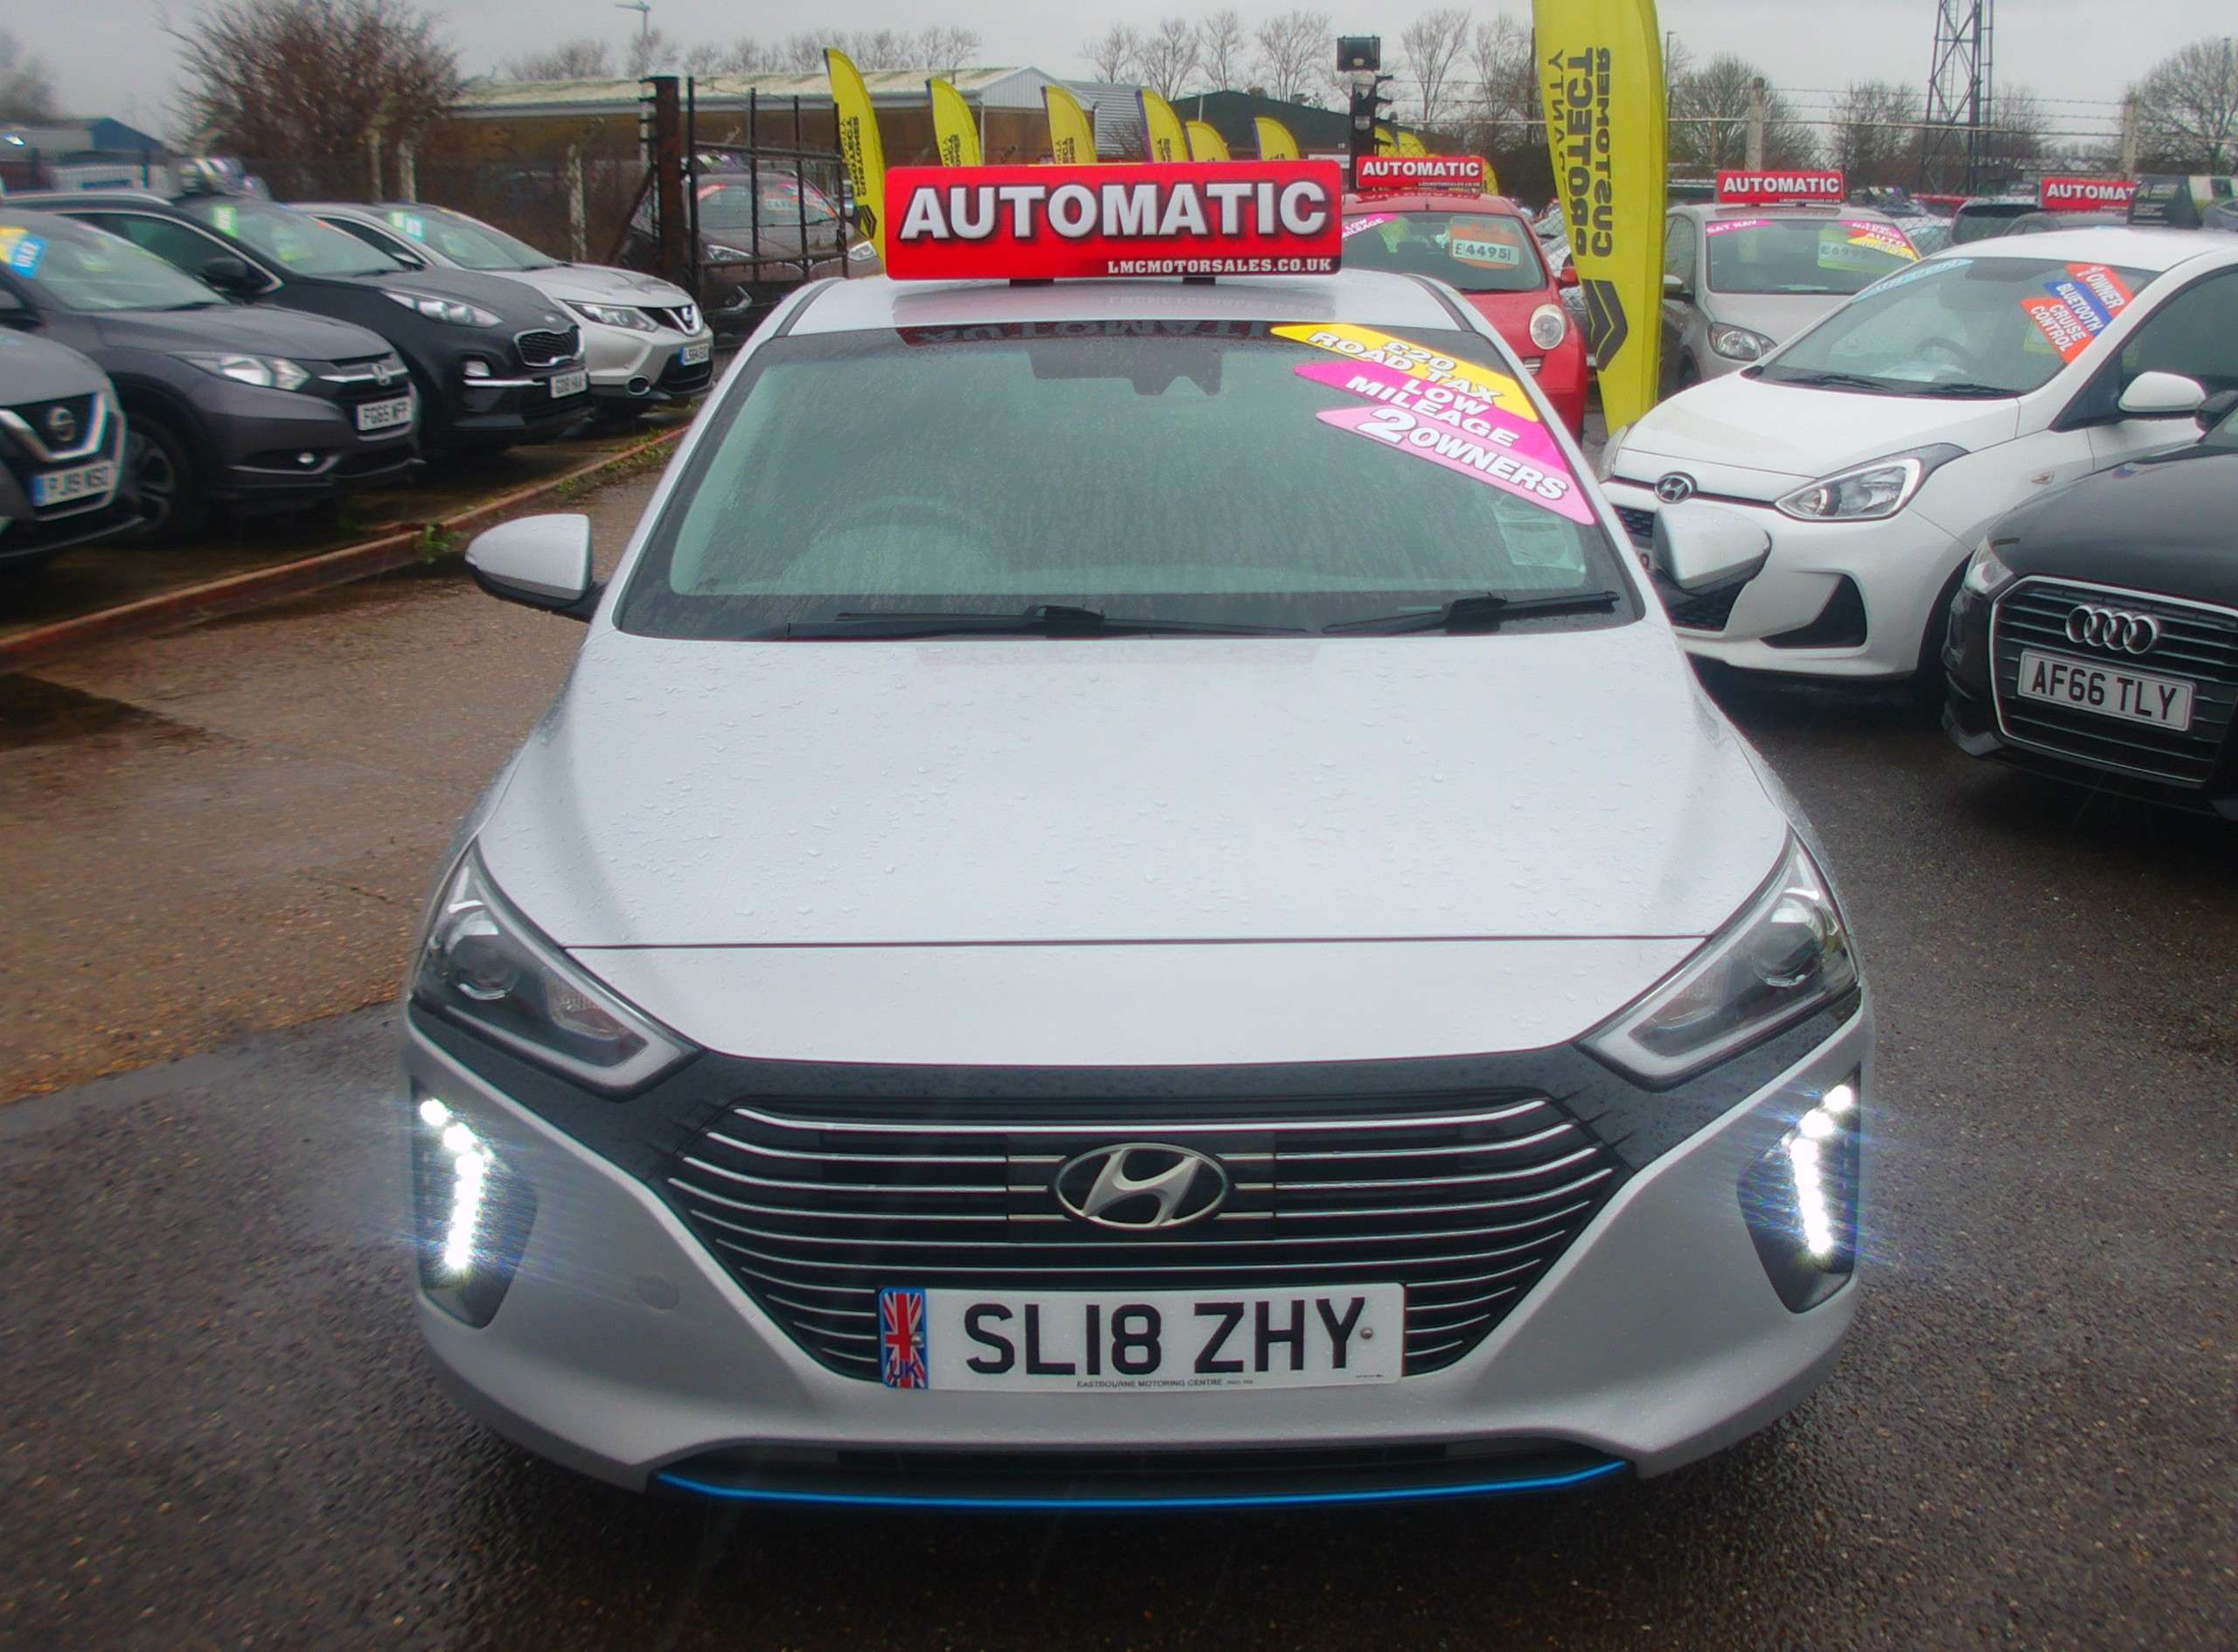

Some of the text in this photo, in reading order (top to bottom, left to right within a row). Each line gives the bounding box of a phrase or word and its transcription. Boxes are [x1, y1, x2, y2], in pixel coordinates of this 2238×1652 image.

[1362, 162, 1479, 177] AUTOMATIC
[1723, 177, 1839, 193] AUTOMATIC
[900, 180, 1326, 240] AUTOMATIC
[1108, 258, 1331, 274] LMCMOTORSALES.CO.UK
[2055, 282, 2104, 331] BLUETOOTH
[2085, 273, 2125, 309] OWNER
[2030, 305, 2074, 351] CONTROL
[2049, 304, 2087, 342] CRUISE
[1308, 331, 1505, 405] ROAD TAX
[1381, 341, 1456, 371] £20
[1345, 376, 1520, 448] MILEAGE
[1401, 378, 1490, 416] LOW
[2032, 661, 2177, 720] AF66 TLY
[964, 1297, 1366, 1376] SL18 ZHY
[890, 1360, 921, 1379] UK
